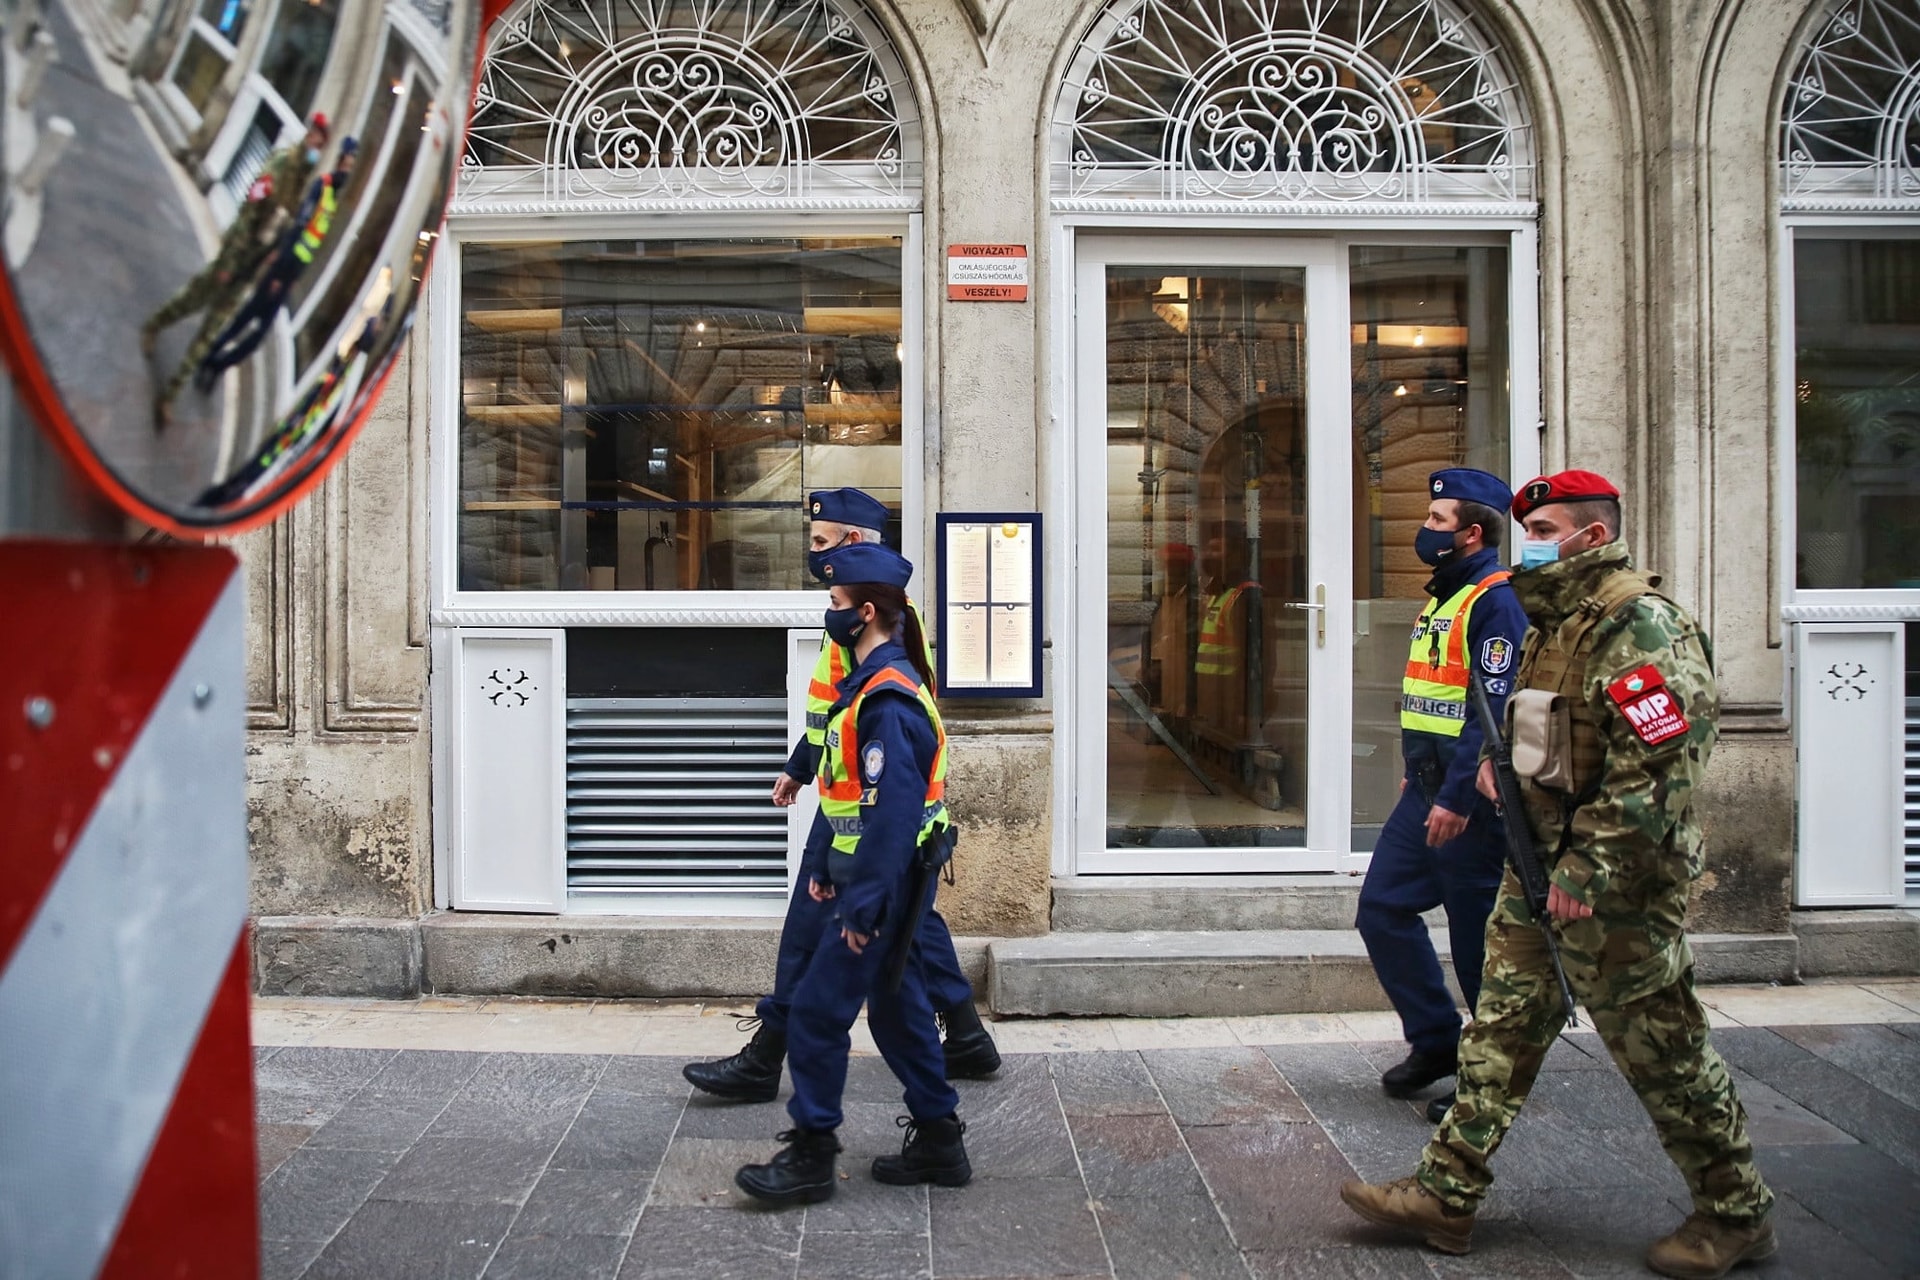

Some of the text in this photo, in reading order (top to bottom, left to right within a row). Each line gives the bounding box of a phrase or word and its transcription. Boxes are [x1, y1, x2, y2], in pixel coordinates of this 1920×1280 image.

[962, 246, 1014, 255] VIGYÁZAT!
[964, 287, 1012, 296] VESZÉLY!
[1409, 697, 1457, 716] POLICE
[1625, 693, 1669, 726] MP
[1641, 713, 1678, 734] KATONAI
